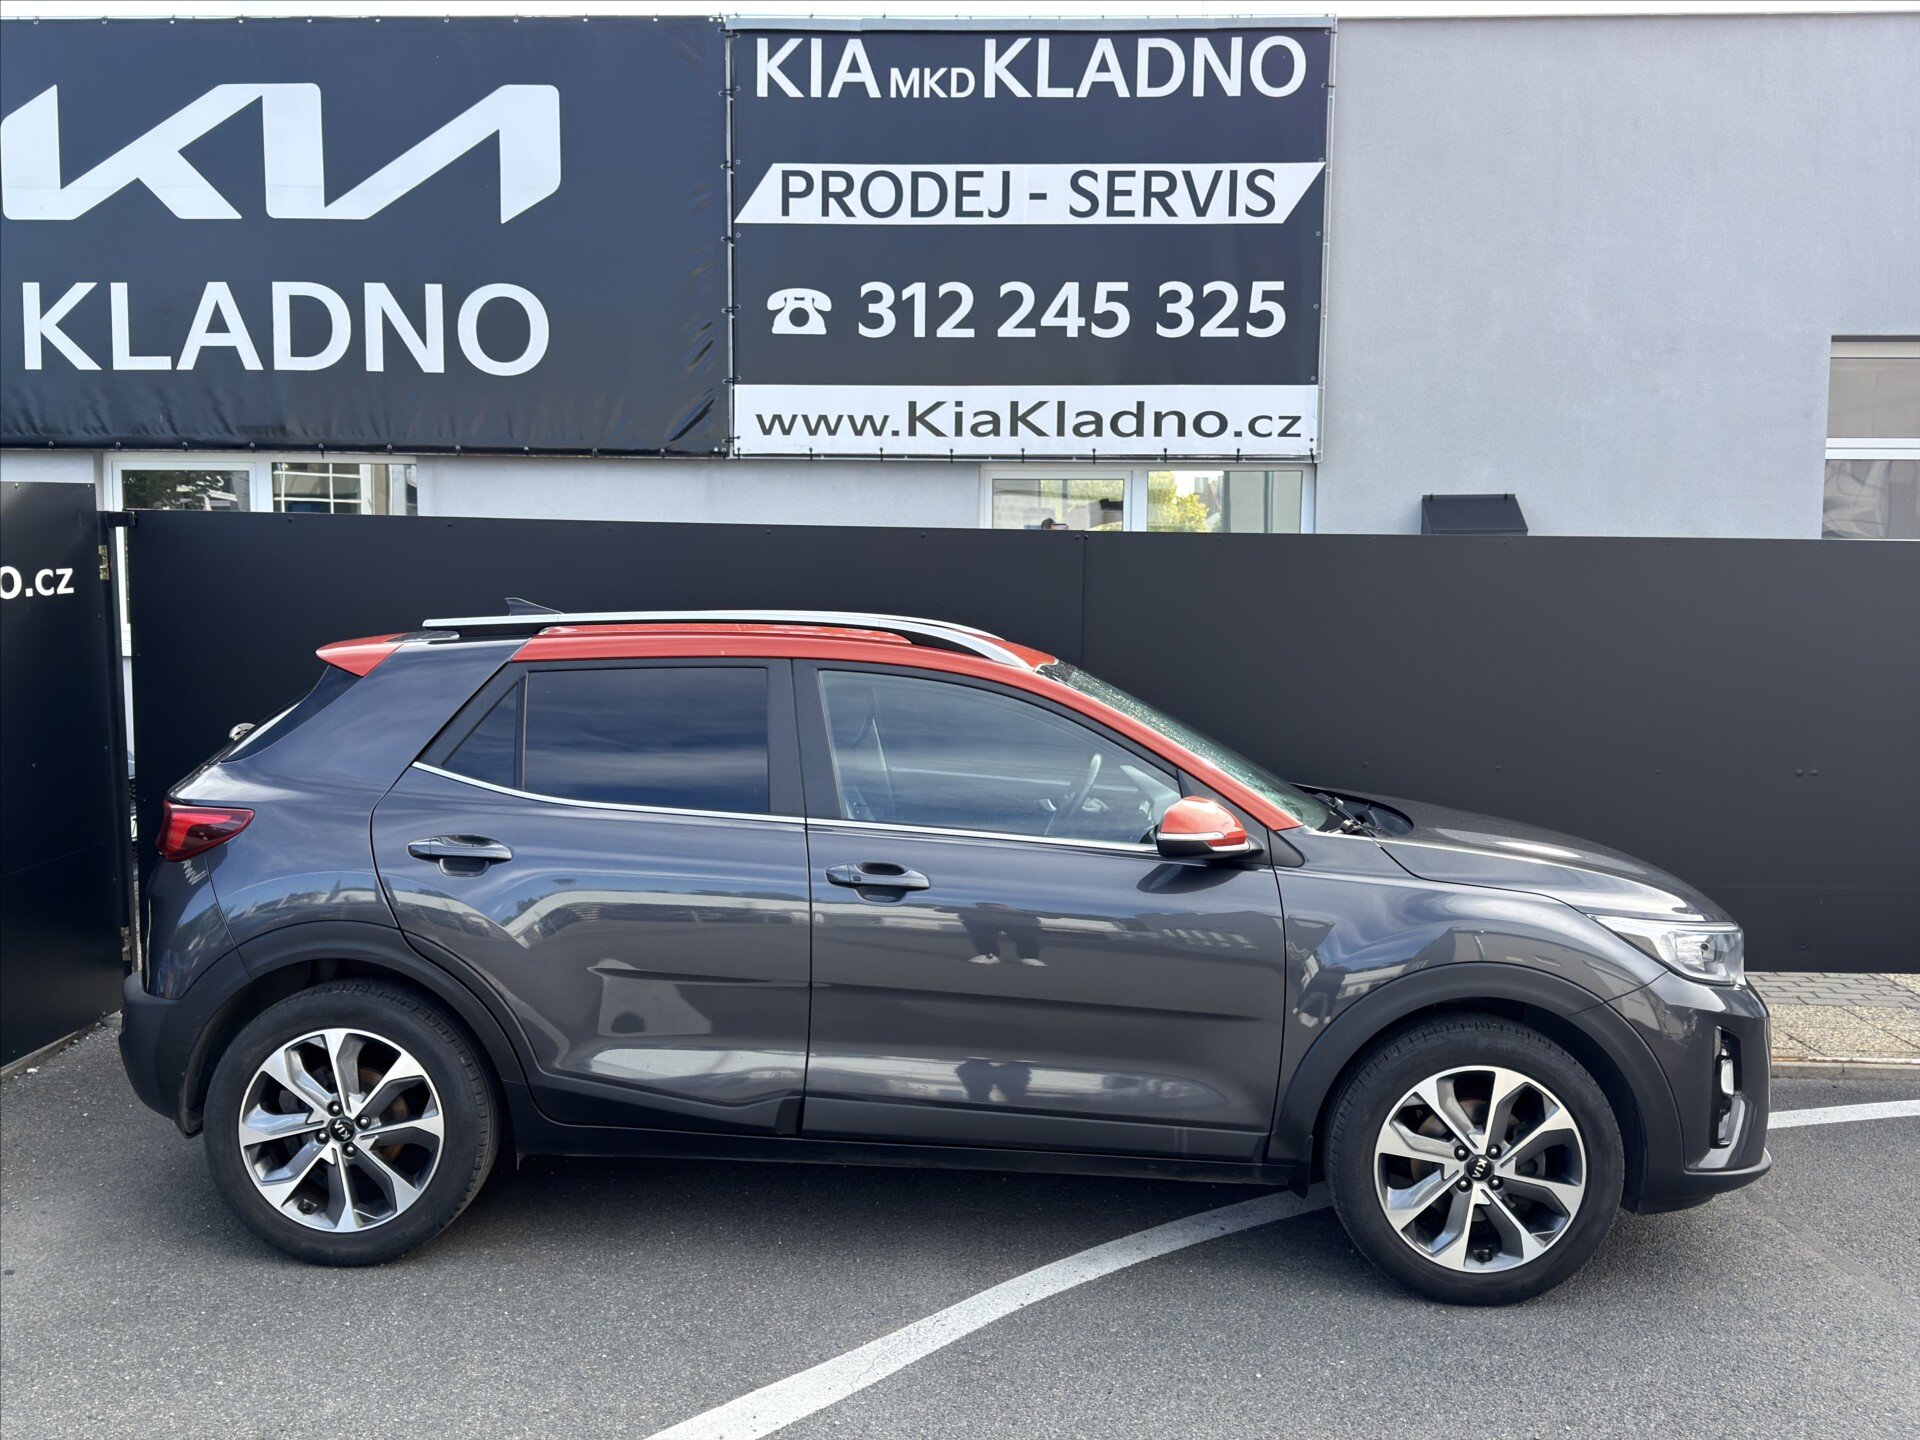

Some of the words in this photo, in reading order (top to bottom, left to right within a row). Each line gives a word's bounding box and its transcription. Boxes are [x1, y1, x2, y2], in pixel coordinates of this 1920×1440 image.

[757, 38, 881, 98] KIA
[890, 68, 976, 98] MKD
[984, 36, 1307, 98] KLADNO
[0, 83, 562, 224] KIA
[781, 170, 1011, 218] PRODEJ
[1069, 169, 1276, 218] SERVIS
[22, 282, 550, 377] KLADNO
[858, 281, 975, 338] 312
[997, 281, 1131, 338] 245
[1156, 281, 1286, 338] 325
[755, 400, 1302, 439] www.KiaKladno.cz
[334, 1120, 351, 1140] KIA
[1472, 1158, 1488, 1178] KIA
